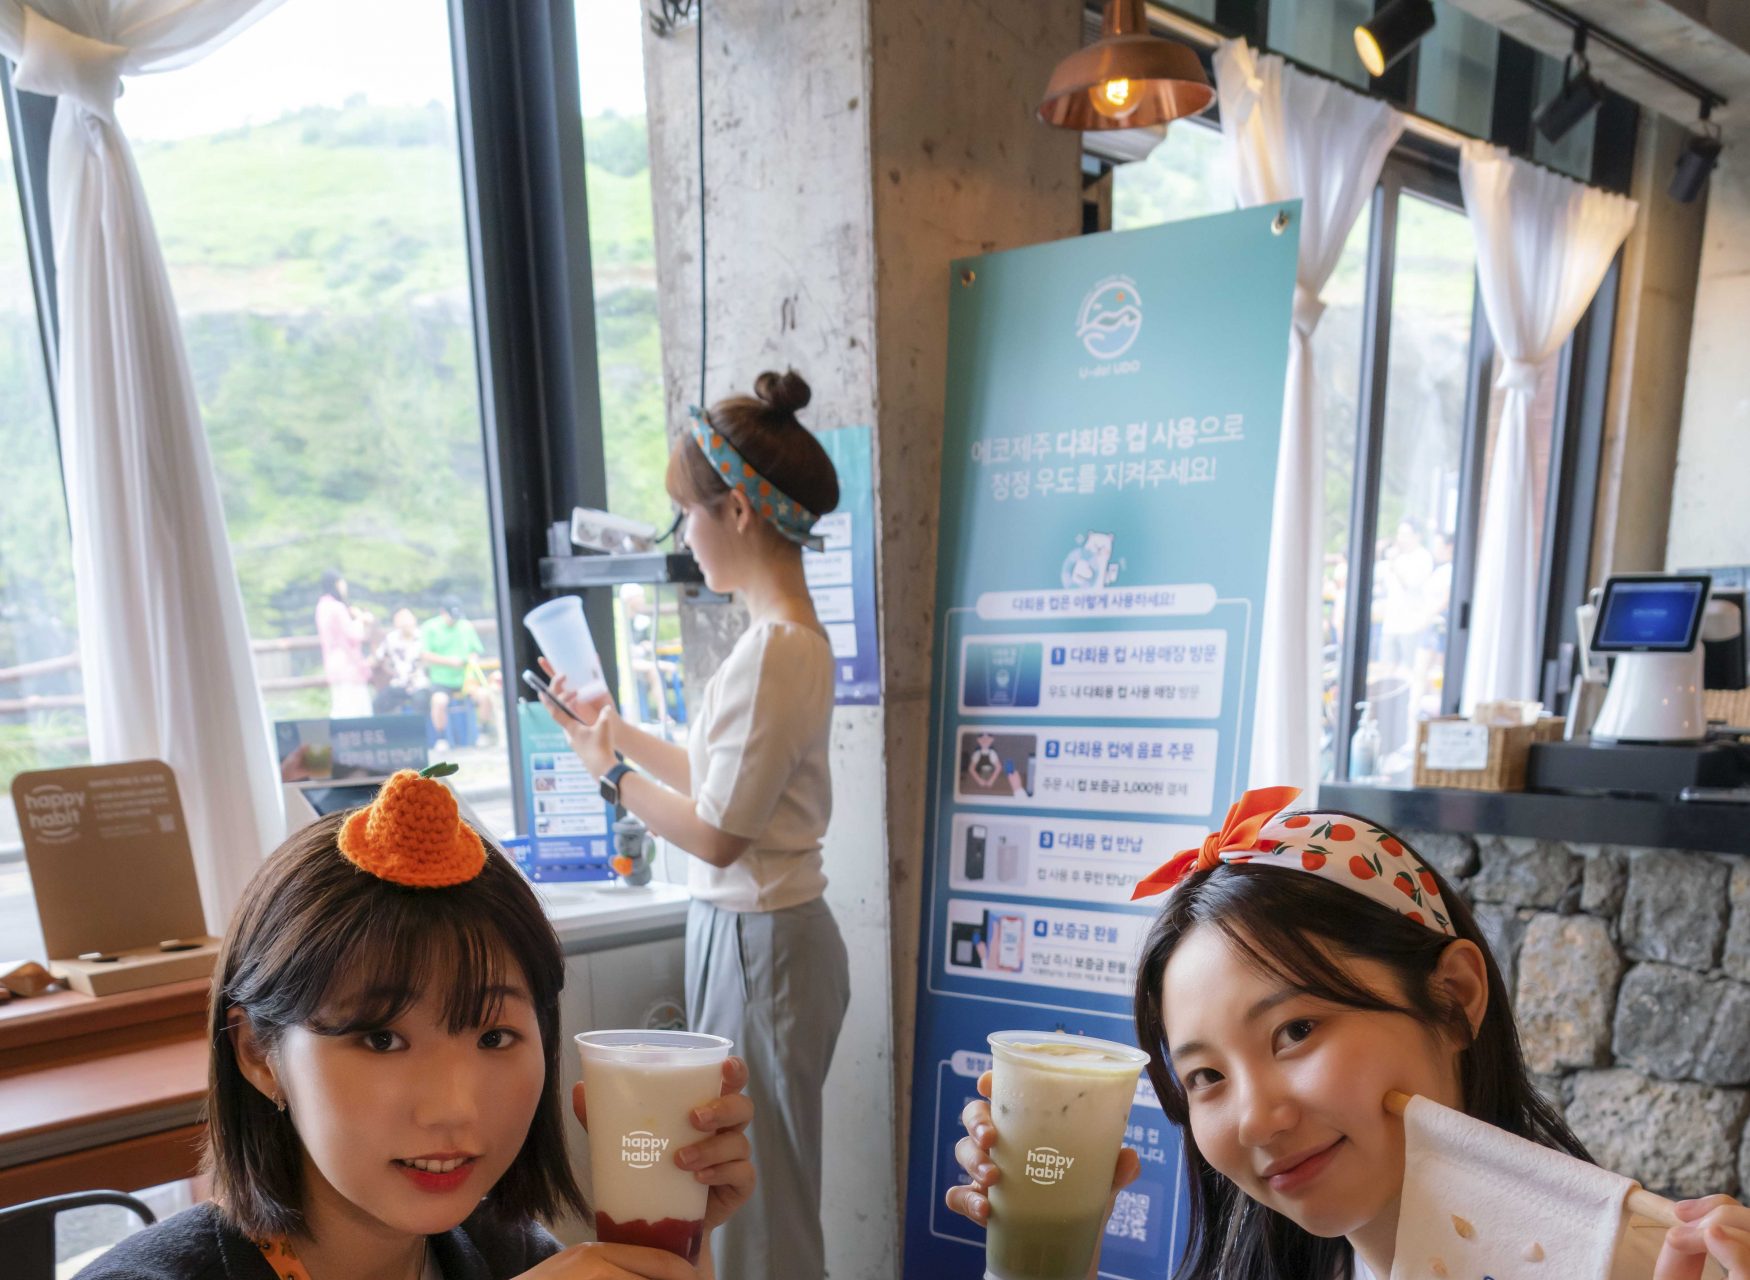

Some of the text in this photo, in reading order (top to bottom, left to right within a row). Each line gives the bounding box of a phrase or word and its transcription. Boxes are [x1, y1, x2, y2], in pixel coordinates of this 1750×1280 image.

[971, 413, 1246, 466] 에코제주 다회용 컵 사용으로
[991, 455, 1217, 501] 청정 우도를 지켜주세요!
[1012, 597, 1045, 612] 다회용
[1049, 596, 1070, 611] 컵은
[1073, 594, 1109, 610] 이렇게
[1070, 646, 1110, 664] 다회용
[1114, 645, 1127, 663] 컵
[1189, 644, 1217, 663] 방문
[1083, 685, 1114, 698] 다회용
[1117, 685, 1128, 699] 컵
[1130, 685, 1150, 699] 사용
[1153, 685, 1176, 699] 매장
[1064, 741, 1103, 758] 다회용
[1107, 741, 1134, 759] 컵에
[1137, 741, 1163, 760] 음료
[1167, 742, 1195, 761] 주문
[1077, 778, 1088, 792] 컵
[1090, 779, 1120, 793] 보증금
[1123, 780, 1164, 795] 1,000원
[24, 790, 86, 810] happy
[28, 809, 81, 829] habit
[1058, 833, 1096, 850] 다회용
[1101, 834, 1113, 852] 컵
[1116, 835, 1143, 853] 반납
[1052, 921, 1090, 940] 보증금
[1094, 925, 1118, 943] 환불
[1075, 957, 1105, 973] 보증금
[622, 1135, 669, 1151] happy
[621, 1149, 661, 1163] habit
[1026, 1150, 1075, 1169] happy
[1025, 1164, 1066, 1180] habit
